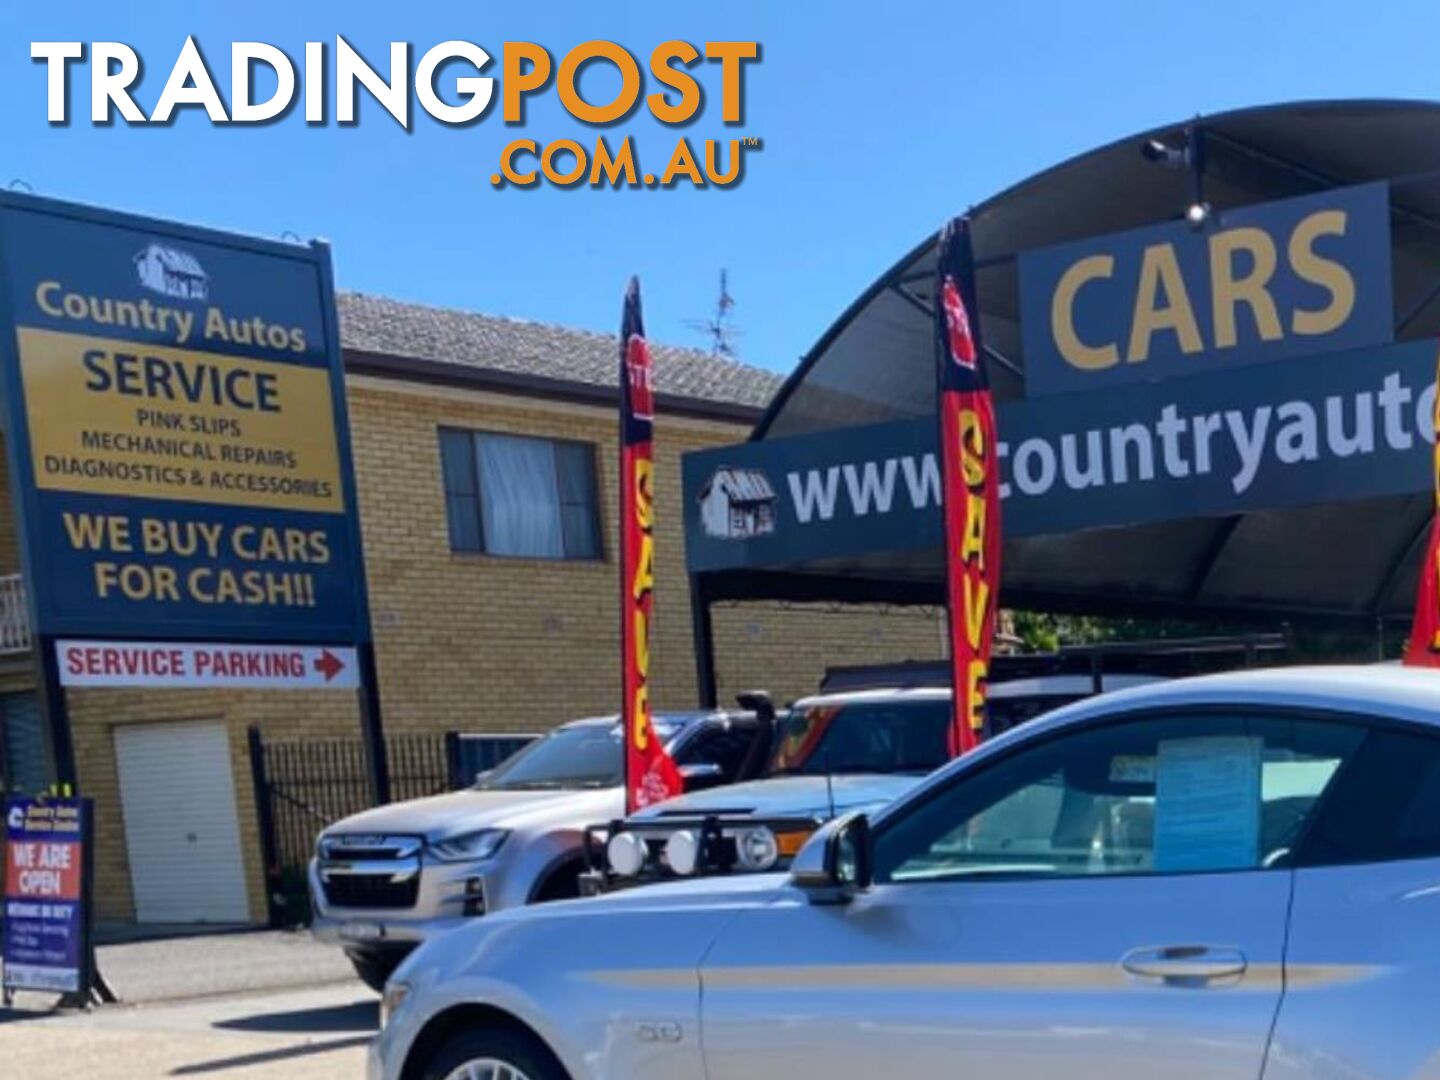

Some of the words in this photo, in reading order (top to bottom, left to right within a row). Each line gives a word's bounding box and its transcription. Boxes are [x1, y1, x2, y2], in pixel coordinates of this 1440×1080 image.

[1051, 210, 1356, 371] CARS
[35, 281, 194, 344] Country
[203, 307, 306, 352] Autos
[83, 349, 283, 414] SERVICE
[136, 407, 184, 433] PINK
[189, 412, 242, 438] SLIPS
[81, 429, 216, 462] MECHANICAL
[220, 444, 298, 470] REPAIRS
[44, 454, 187, 485] DIAGNOSTICS
[210, 470, 332, 499] ACCESSORIES
[63, 512, 132, 553] WE
[141, 518, 223, 558] BUY
[231, 525, 331, 564] CARS
[93, 561, 181, 602] FOR
[187, 568, 316, 608] CASH!!
[958, 409, 991, 732] SAVE
[66, 648, 186, 677] SERVICE
[195, 652, 306, 678] PARKING
